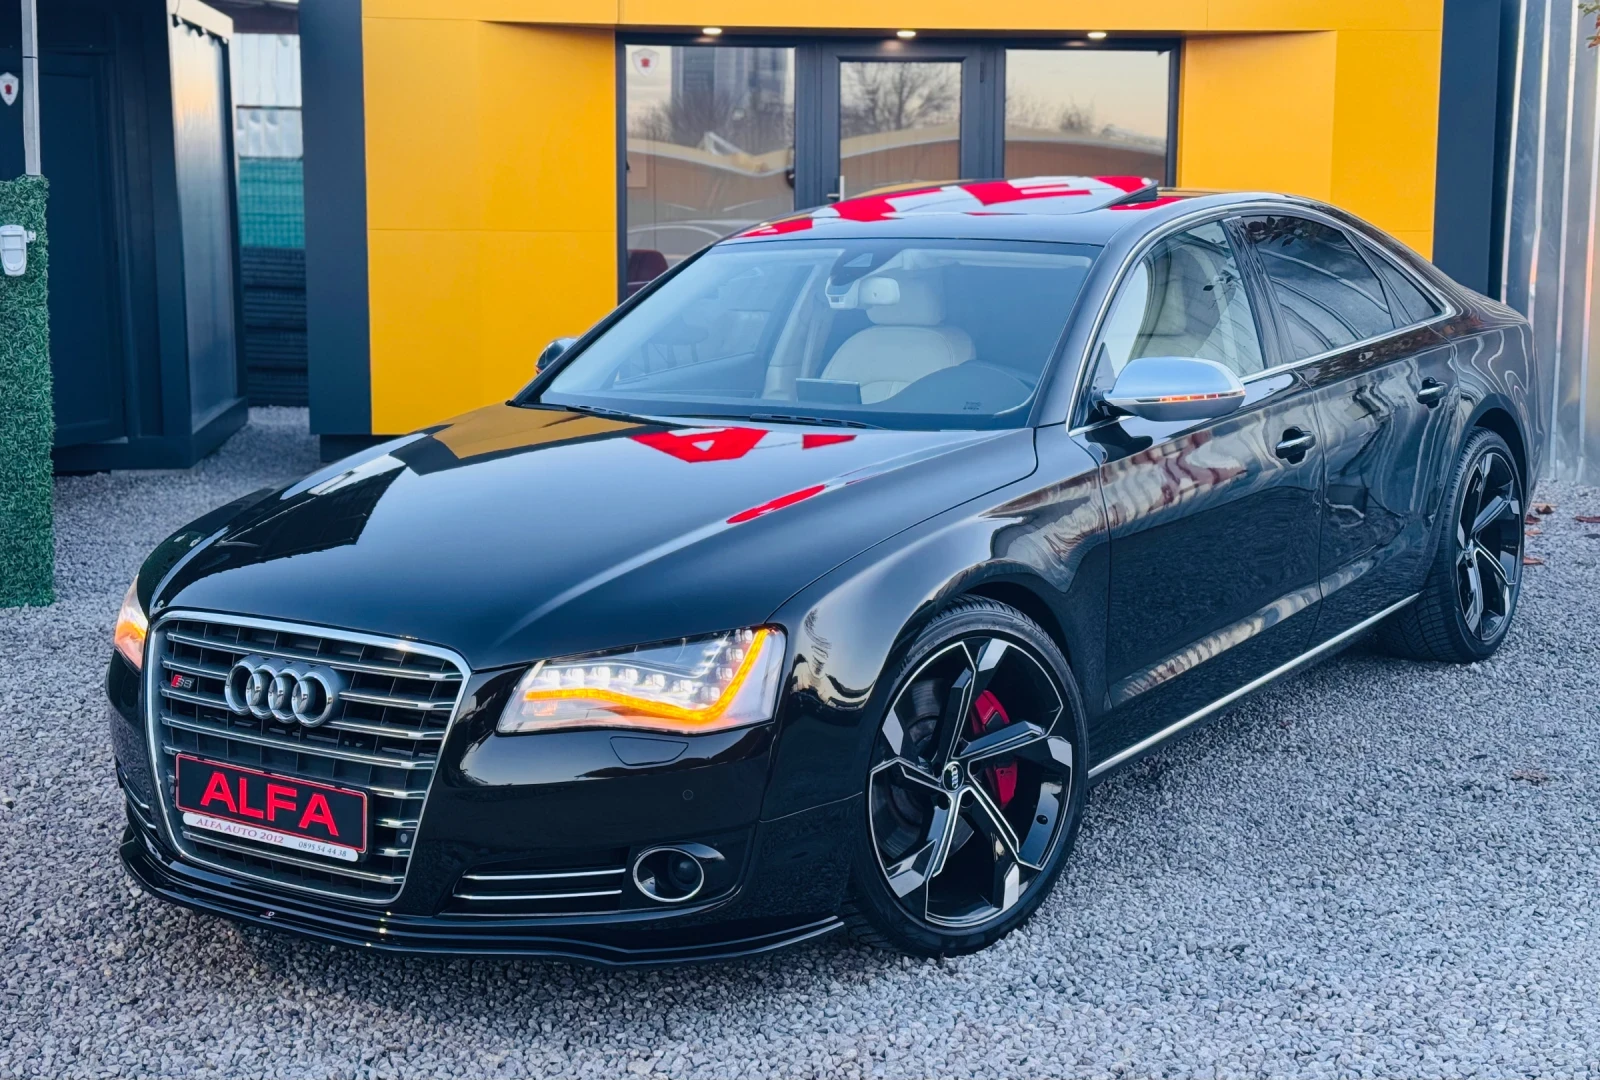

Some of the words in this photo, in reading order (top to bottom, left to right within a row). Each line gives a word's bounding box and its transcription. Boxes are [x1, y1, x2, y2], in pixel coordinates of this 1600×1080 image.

[200, 772, 339, 836] ALFA
[196, 818, 222, 830] ALFA
[224, 825, 257, 838] AUTO
[260, 831, 284, 844] 2012
